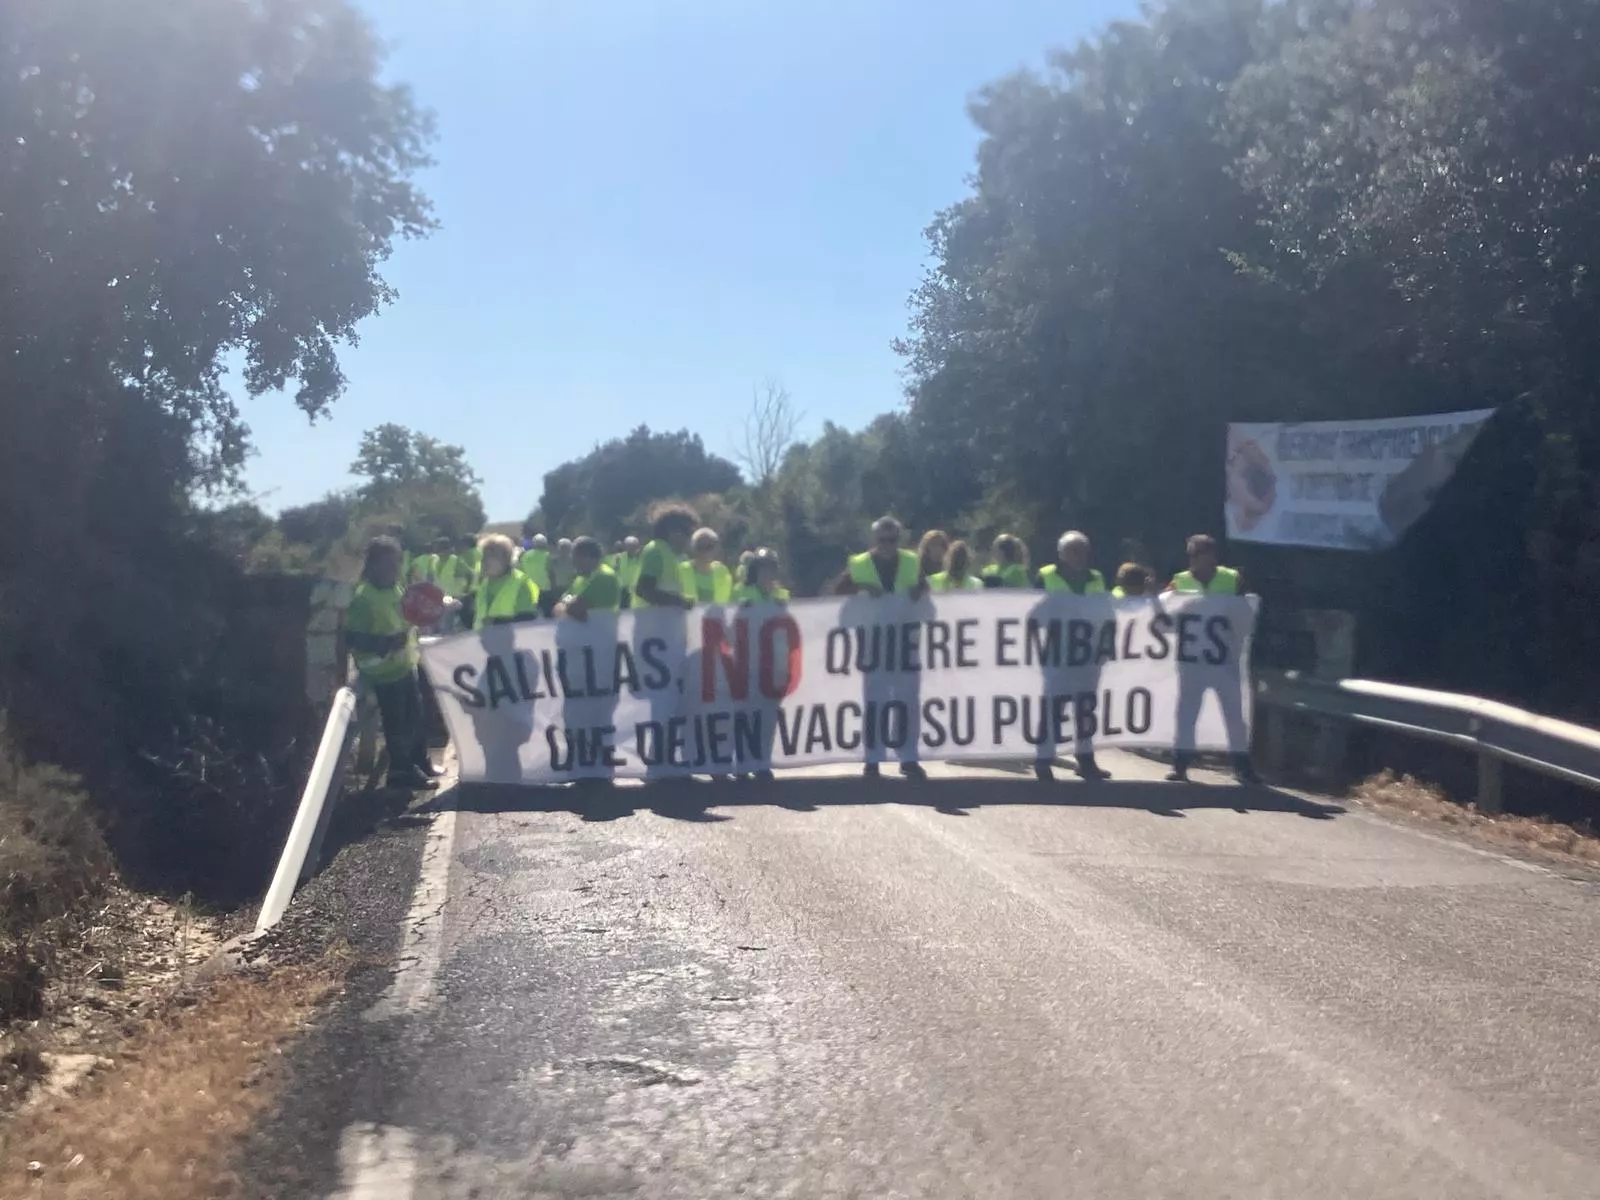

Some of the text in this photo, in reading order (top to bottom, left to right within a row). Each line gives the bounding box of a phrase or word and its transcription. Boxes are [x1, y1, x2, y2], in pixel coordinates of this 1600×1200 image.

[702, 612, 802, 702] NO
[826, 618, 979, 675] QUIERE
[996, 615, 1231, 667] EMBALSES
[546, 687, 1152, 771] QUE DEJEN VACIO SU PUEBLO
